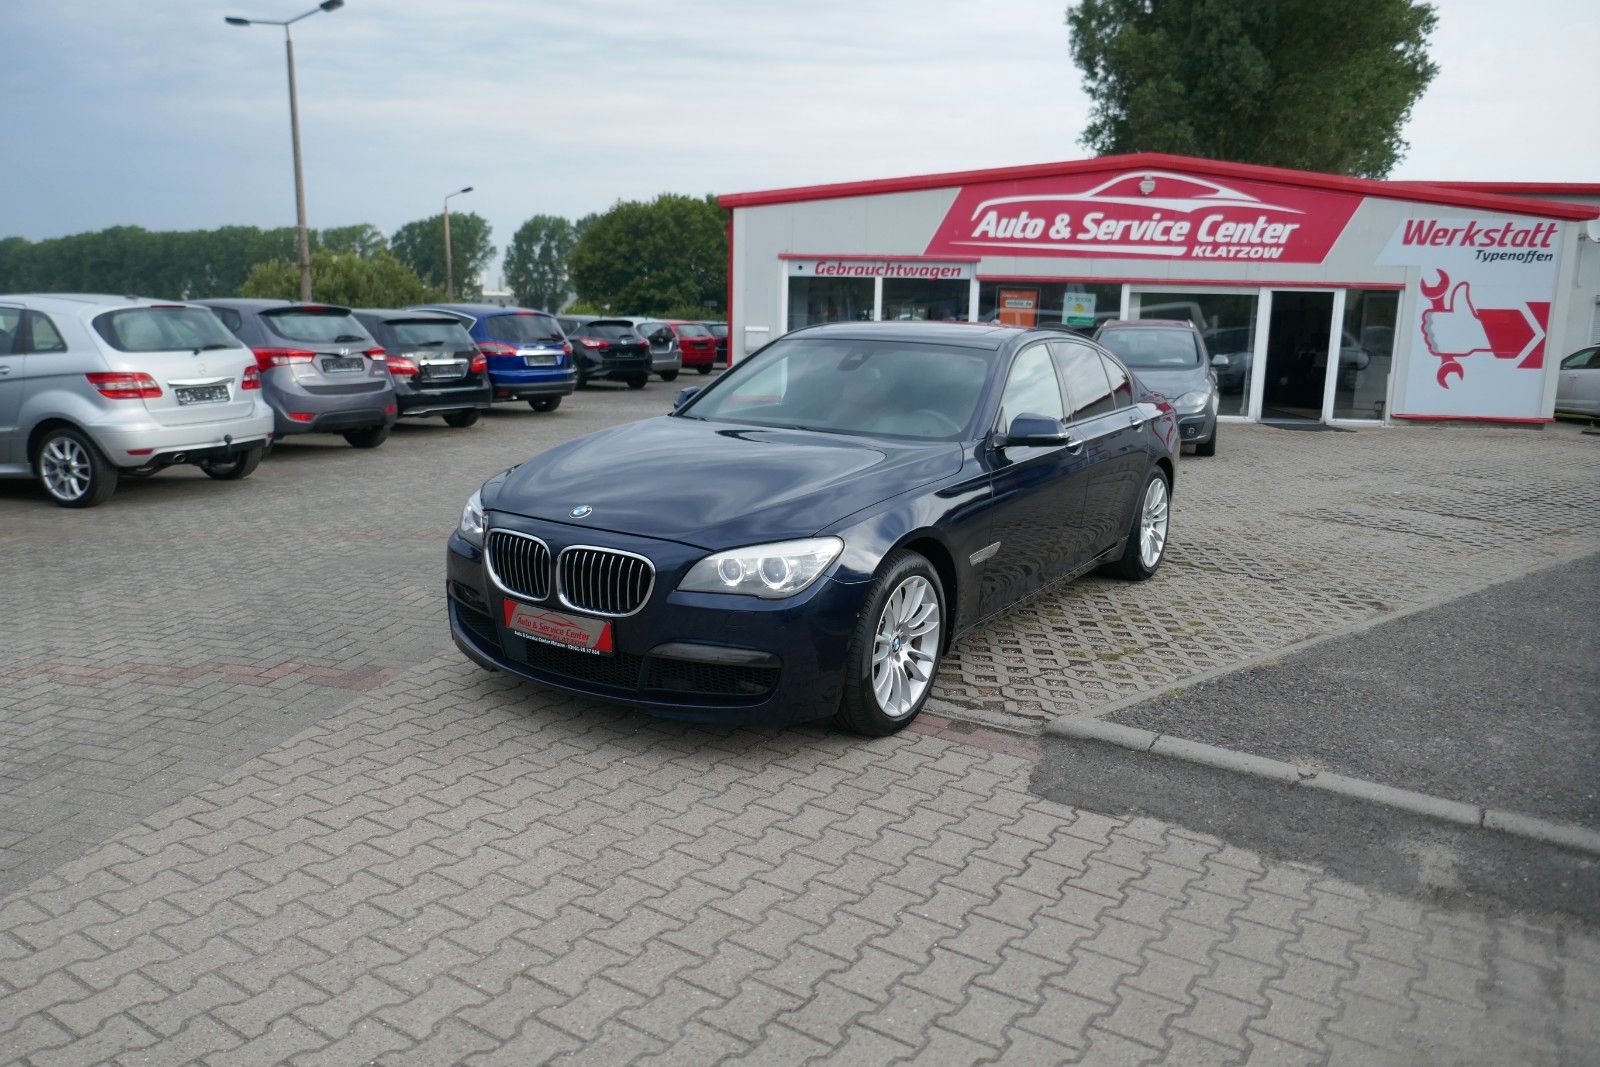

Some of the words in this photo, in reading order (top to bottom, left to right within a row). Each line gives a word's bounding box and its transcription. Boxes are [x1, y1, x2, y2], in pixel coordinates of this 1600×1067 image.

[971, 210, 1045, 239] Auto
[1049, 213, 1072, 239] &
[1076, 212, 1191, 242] Service
[1196, 214, 1300, 244] Center
[1402, 219, 1558, 248] Werkstatt
[1191, 245, 1283, 259] KLATZOW
[1475, 250, 1553, 263] Typenoffen
[814, 260, 962, 281] Gebrauchtwagen
[517, 616, 532, 629] Auto
[538, 621, 565, 635] Service
[566, 628, 591, 641] Center
